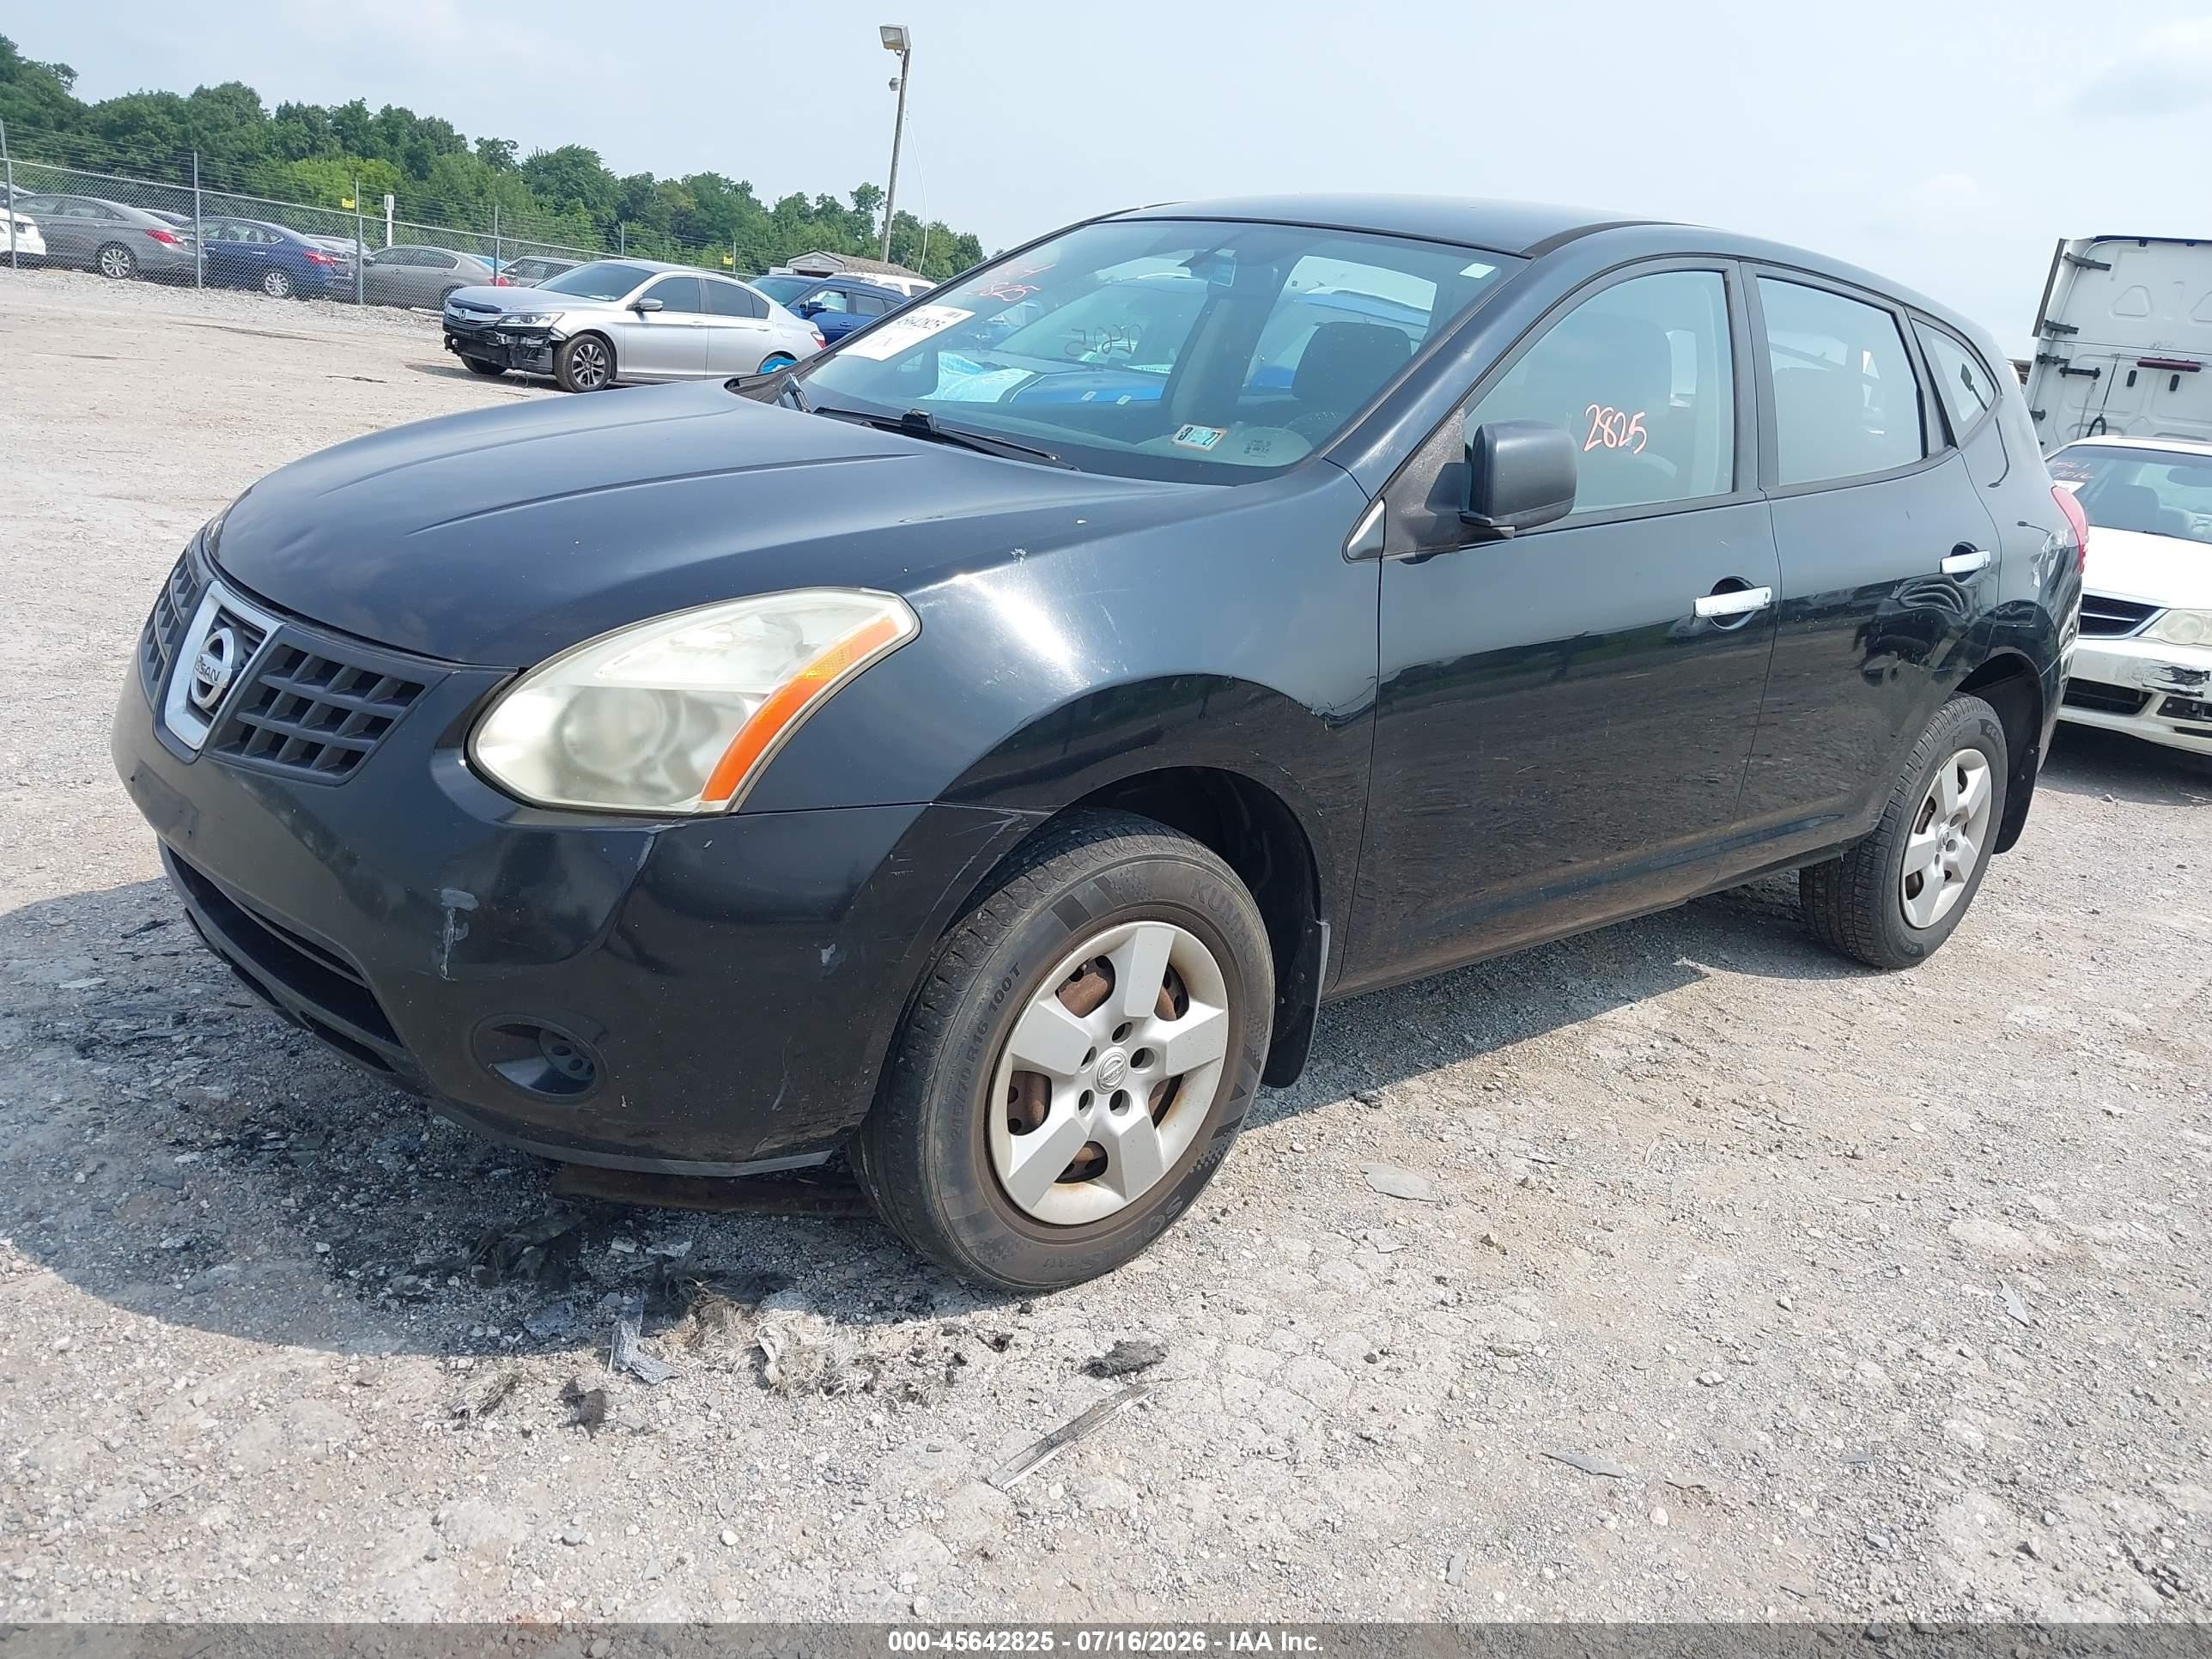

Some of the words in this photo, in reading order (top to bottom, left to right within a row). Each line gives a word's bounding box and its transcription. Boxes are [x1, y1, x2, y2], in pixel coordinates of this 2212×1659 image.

[1177, 427, 1194, 441] 3
[1583, 404, 1648, 454] 2825
[988, 961, 1021, 1014] 100T
